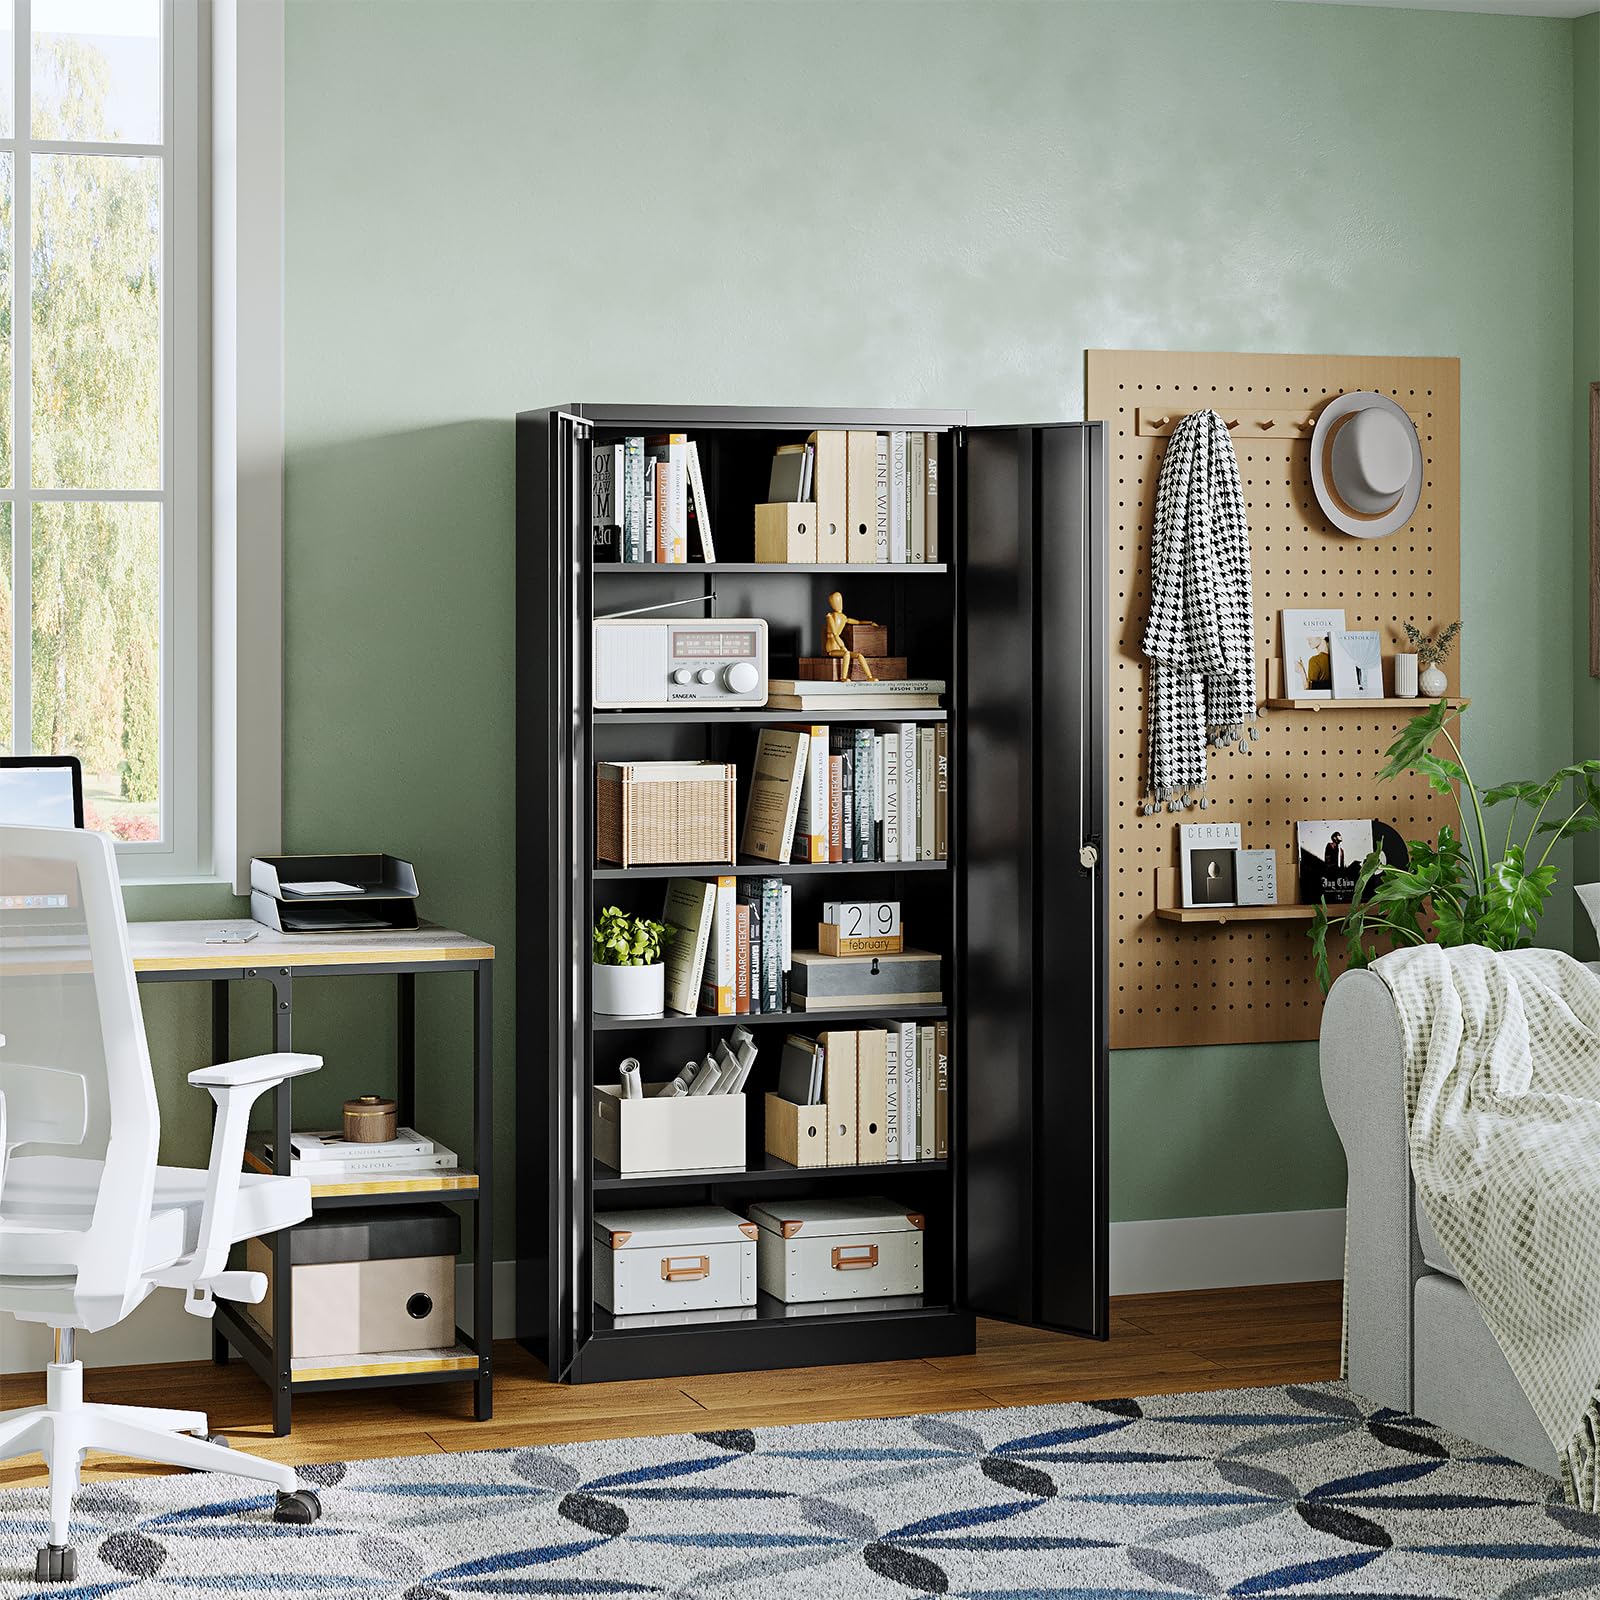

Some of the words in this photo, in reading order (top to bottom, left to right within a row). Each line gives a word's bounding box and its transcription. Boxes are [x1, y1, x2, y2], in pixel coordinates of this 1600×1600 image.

[878, 453, 887, 488] FINE
[895, 432, 904, 486] WINDOWS
[928, 458, 937, 480] ART
[878, 495, 887, 546] WINES
[888, 751, 897, 785] FINE
[905, 727, 913, 783] WINDOWS
[938, 755, 947, 777] ART
[888, 792, 897, 844] WINES
[1188, 827, 1238, 838] CEREAL
[738, 912, 747, 997] INNENARCHITEKTUR
[849, 939, 890, 950] february
[888, 1051, 897, 1084] FINE
[905, 1027, 913, 1083] WINDOWS
[938, 1054, 947, 1076] ART
[888, 1092, 897, 1143] WINES
